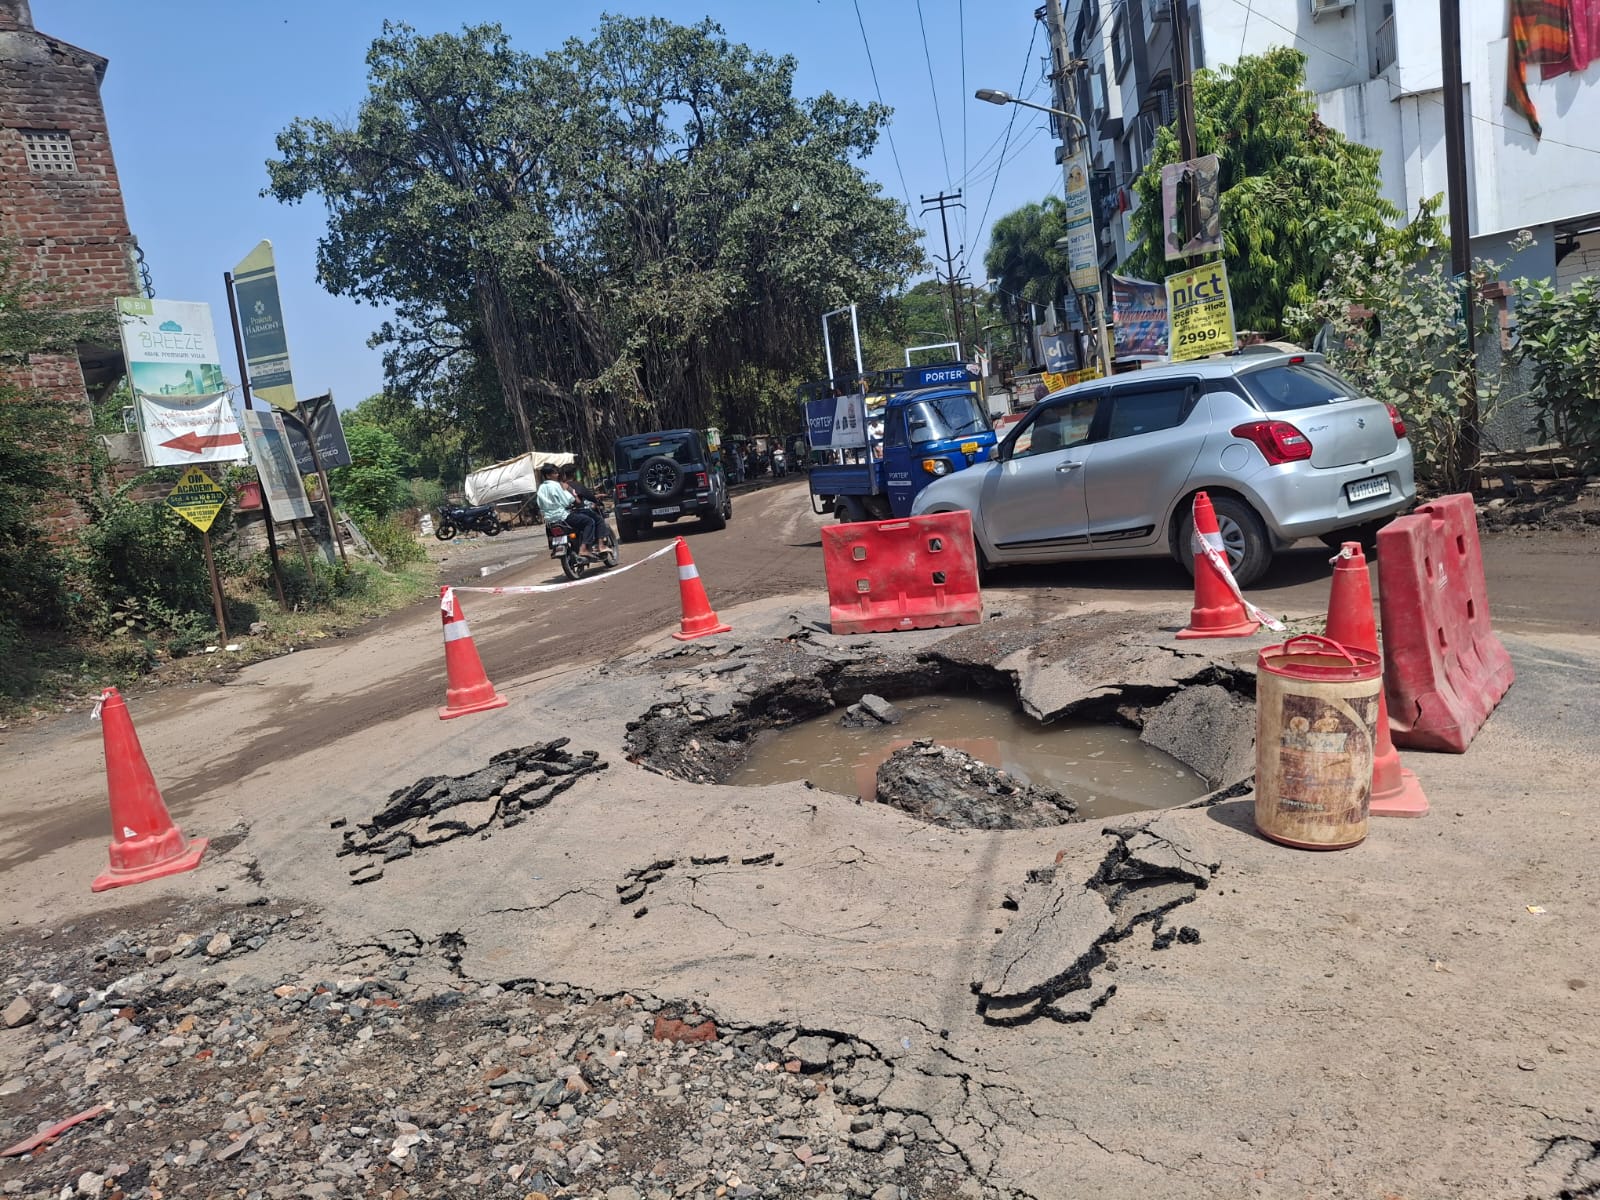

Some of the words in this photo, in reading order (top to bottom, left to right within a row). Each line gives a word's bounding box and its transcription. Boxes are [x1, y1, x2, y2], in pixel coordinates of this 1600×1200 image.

[1173, 273, 1224, 306] nict
[246, 321, 279, 336] HARMONY
[139, 331, 204, 350] BREEZE
[1179, 327, 1227, 346] 2999/-
[925, 371, 962, 382] PORTER
[809, 417, 830, 428] PORTER
[187, 474, 203, 484] OM
[888, 472, 907, 480] PORTER
[177, 484, 213, 493] ACADEMY
